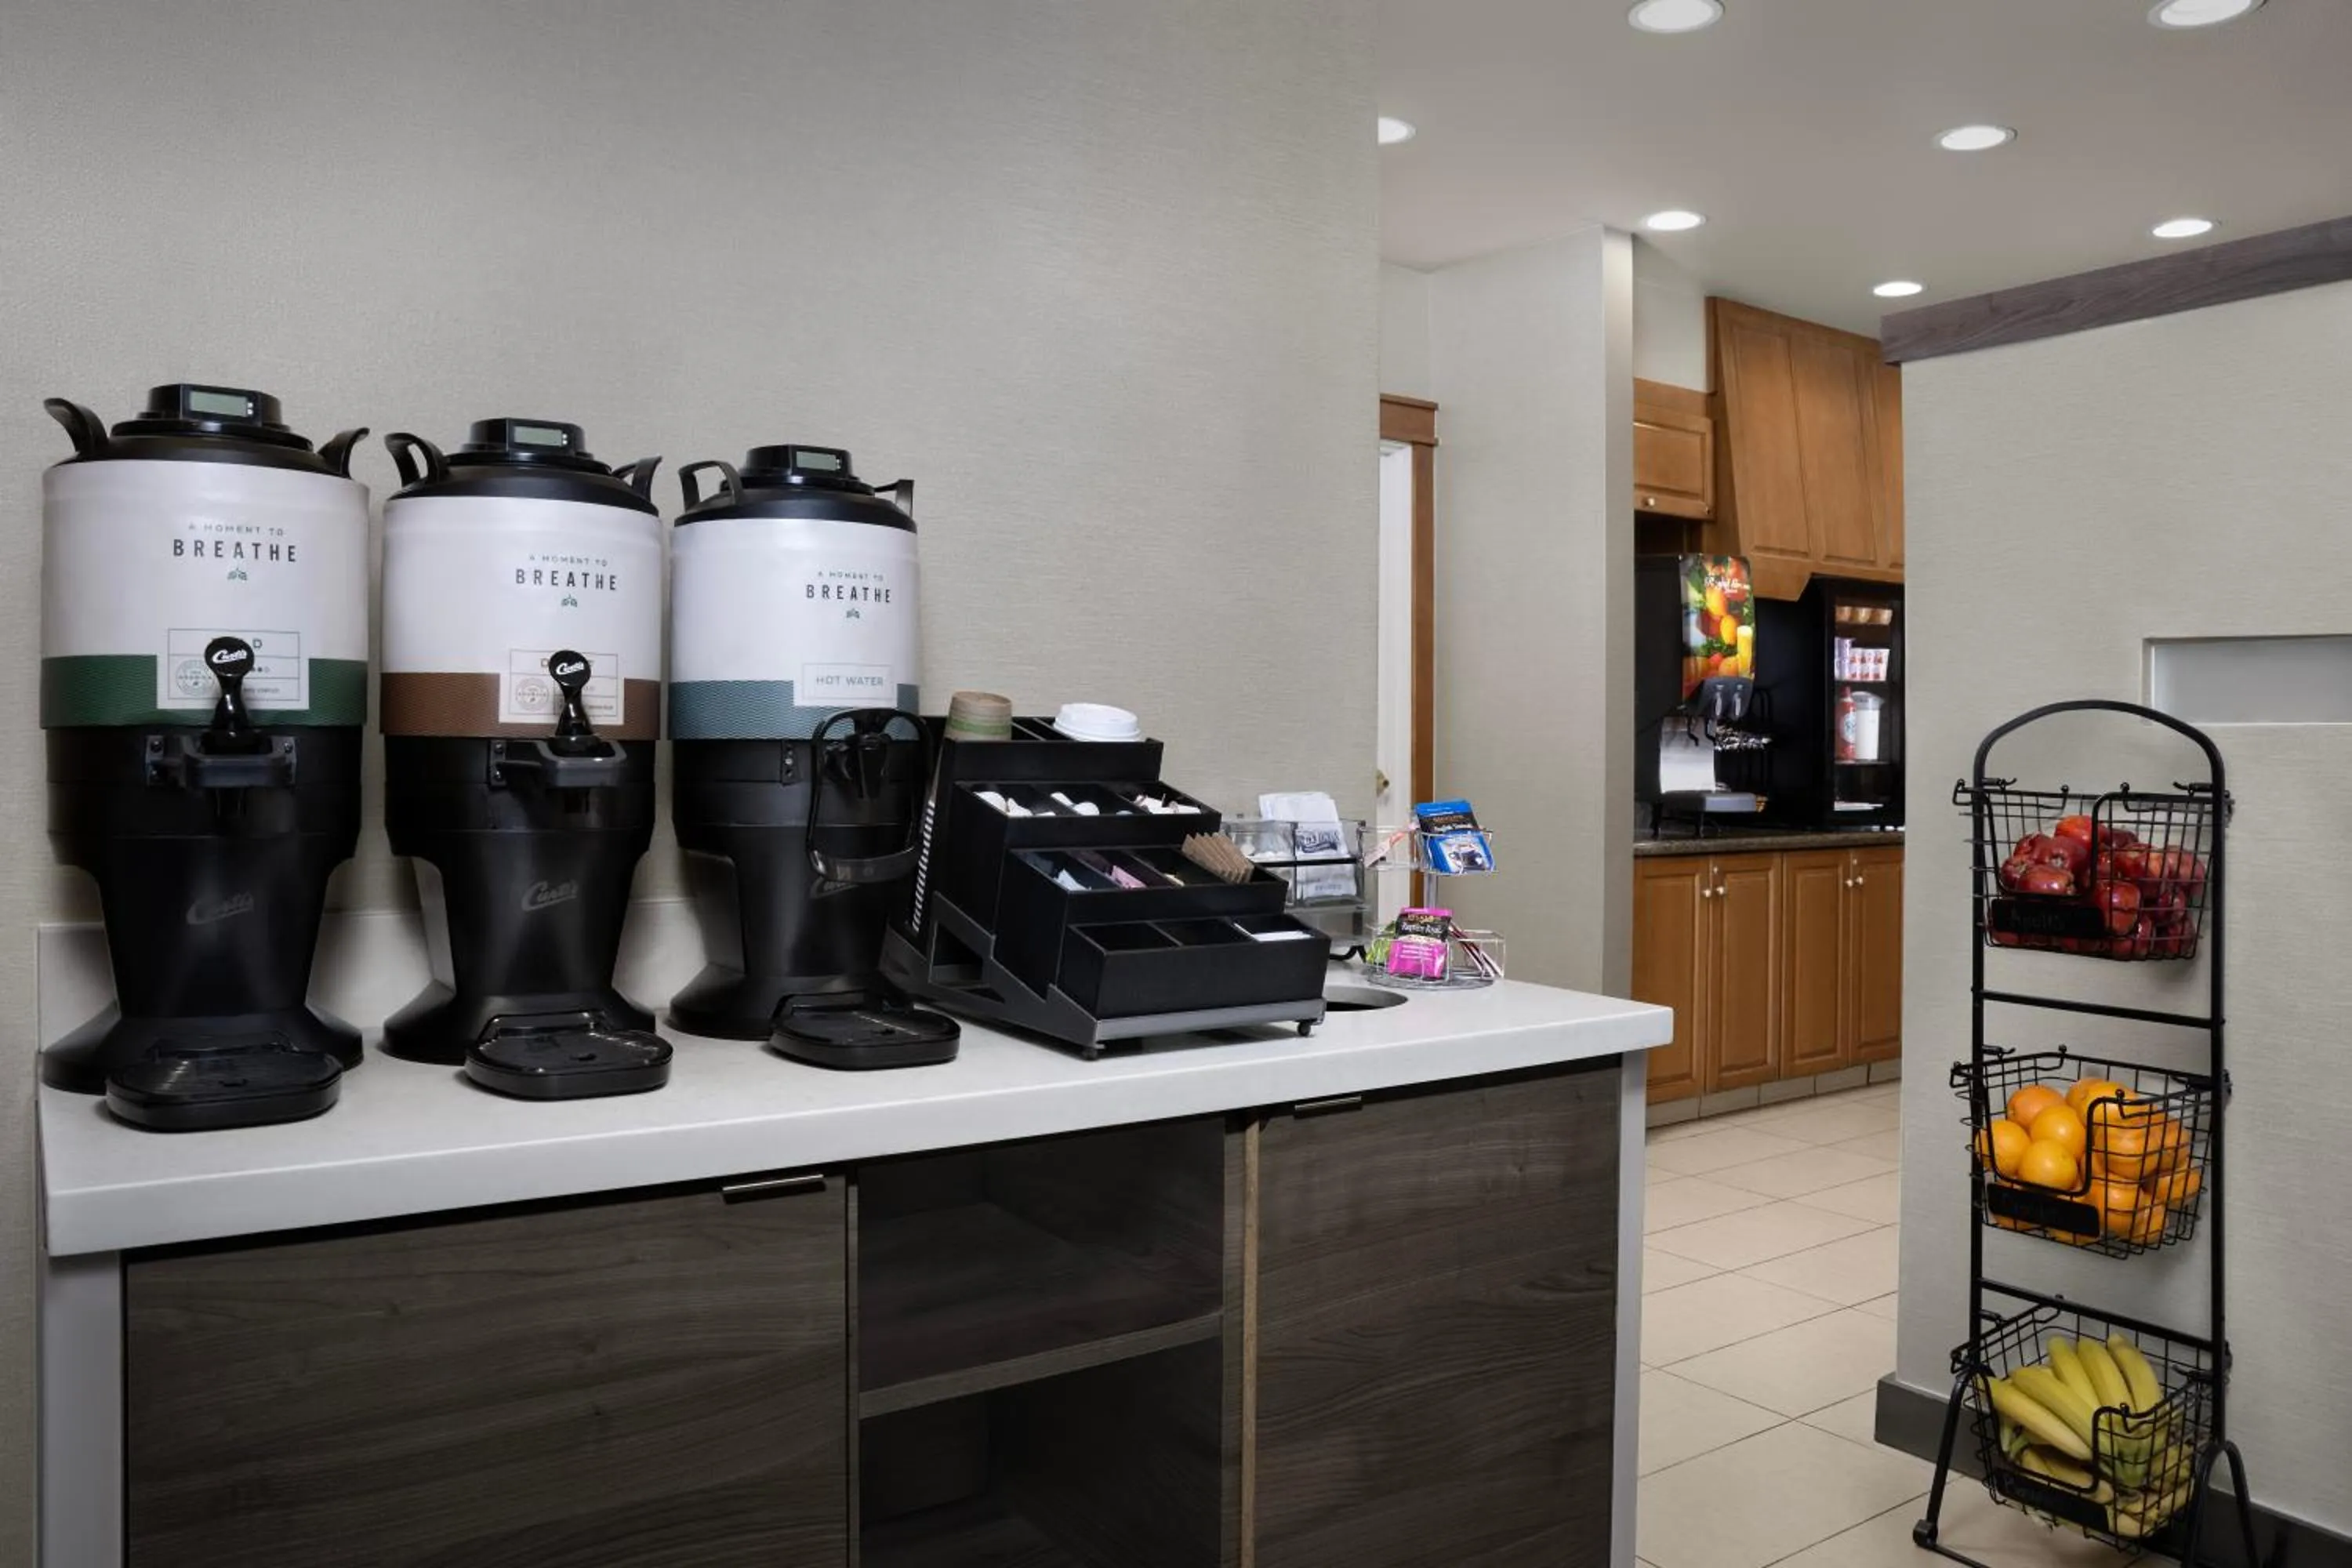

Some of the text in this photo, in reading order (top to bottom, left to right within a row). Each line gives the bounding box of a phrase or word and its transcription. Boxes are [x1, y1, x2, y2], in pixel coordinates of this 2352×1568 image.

[204, 524, 260, 534] MOMENT
[269, 528, 284, 536] TO
[172, 539, 296, 562] BREATHE
[542, 555, 589, 565] MOMENT
[515, 568, 617, 590] BREATHE
[806, 584, 891, 603] BREATHE
[816, 675, 884, 687] HOT WATER
